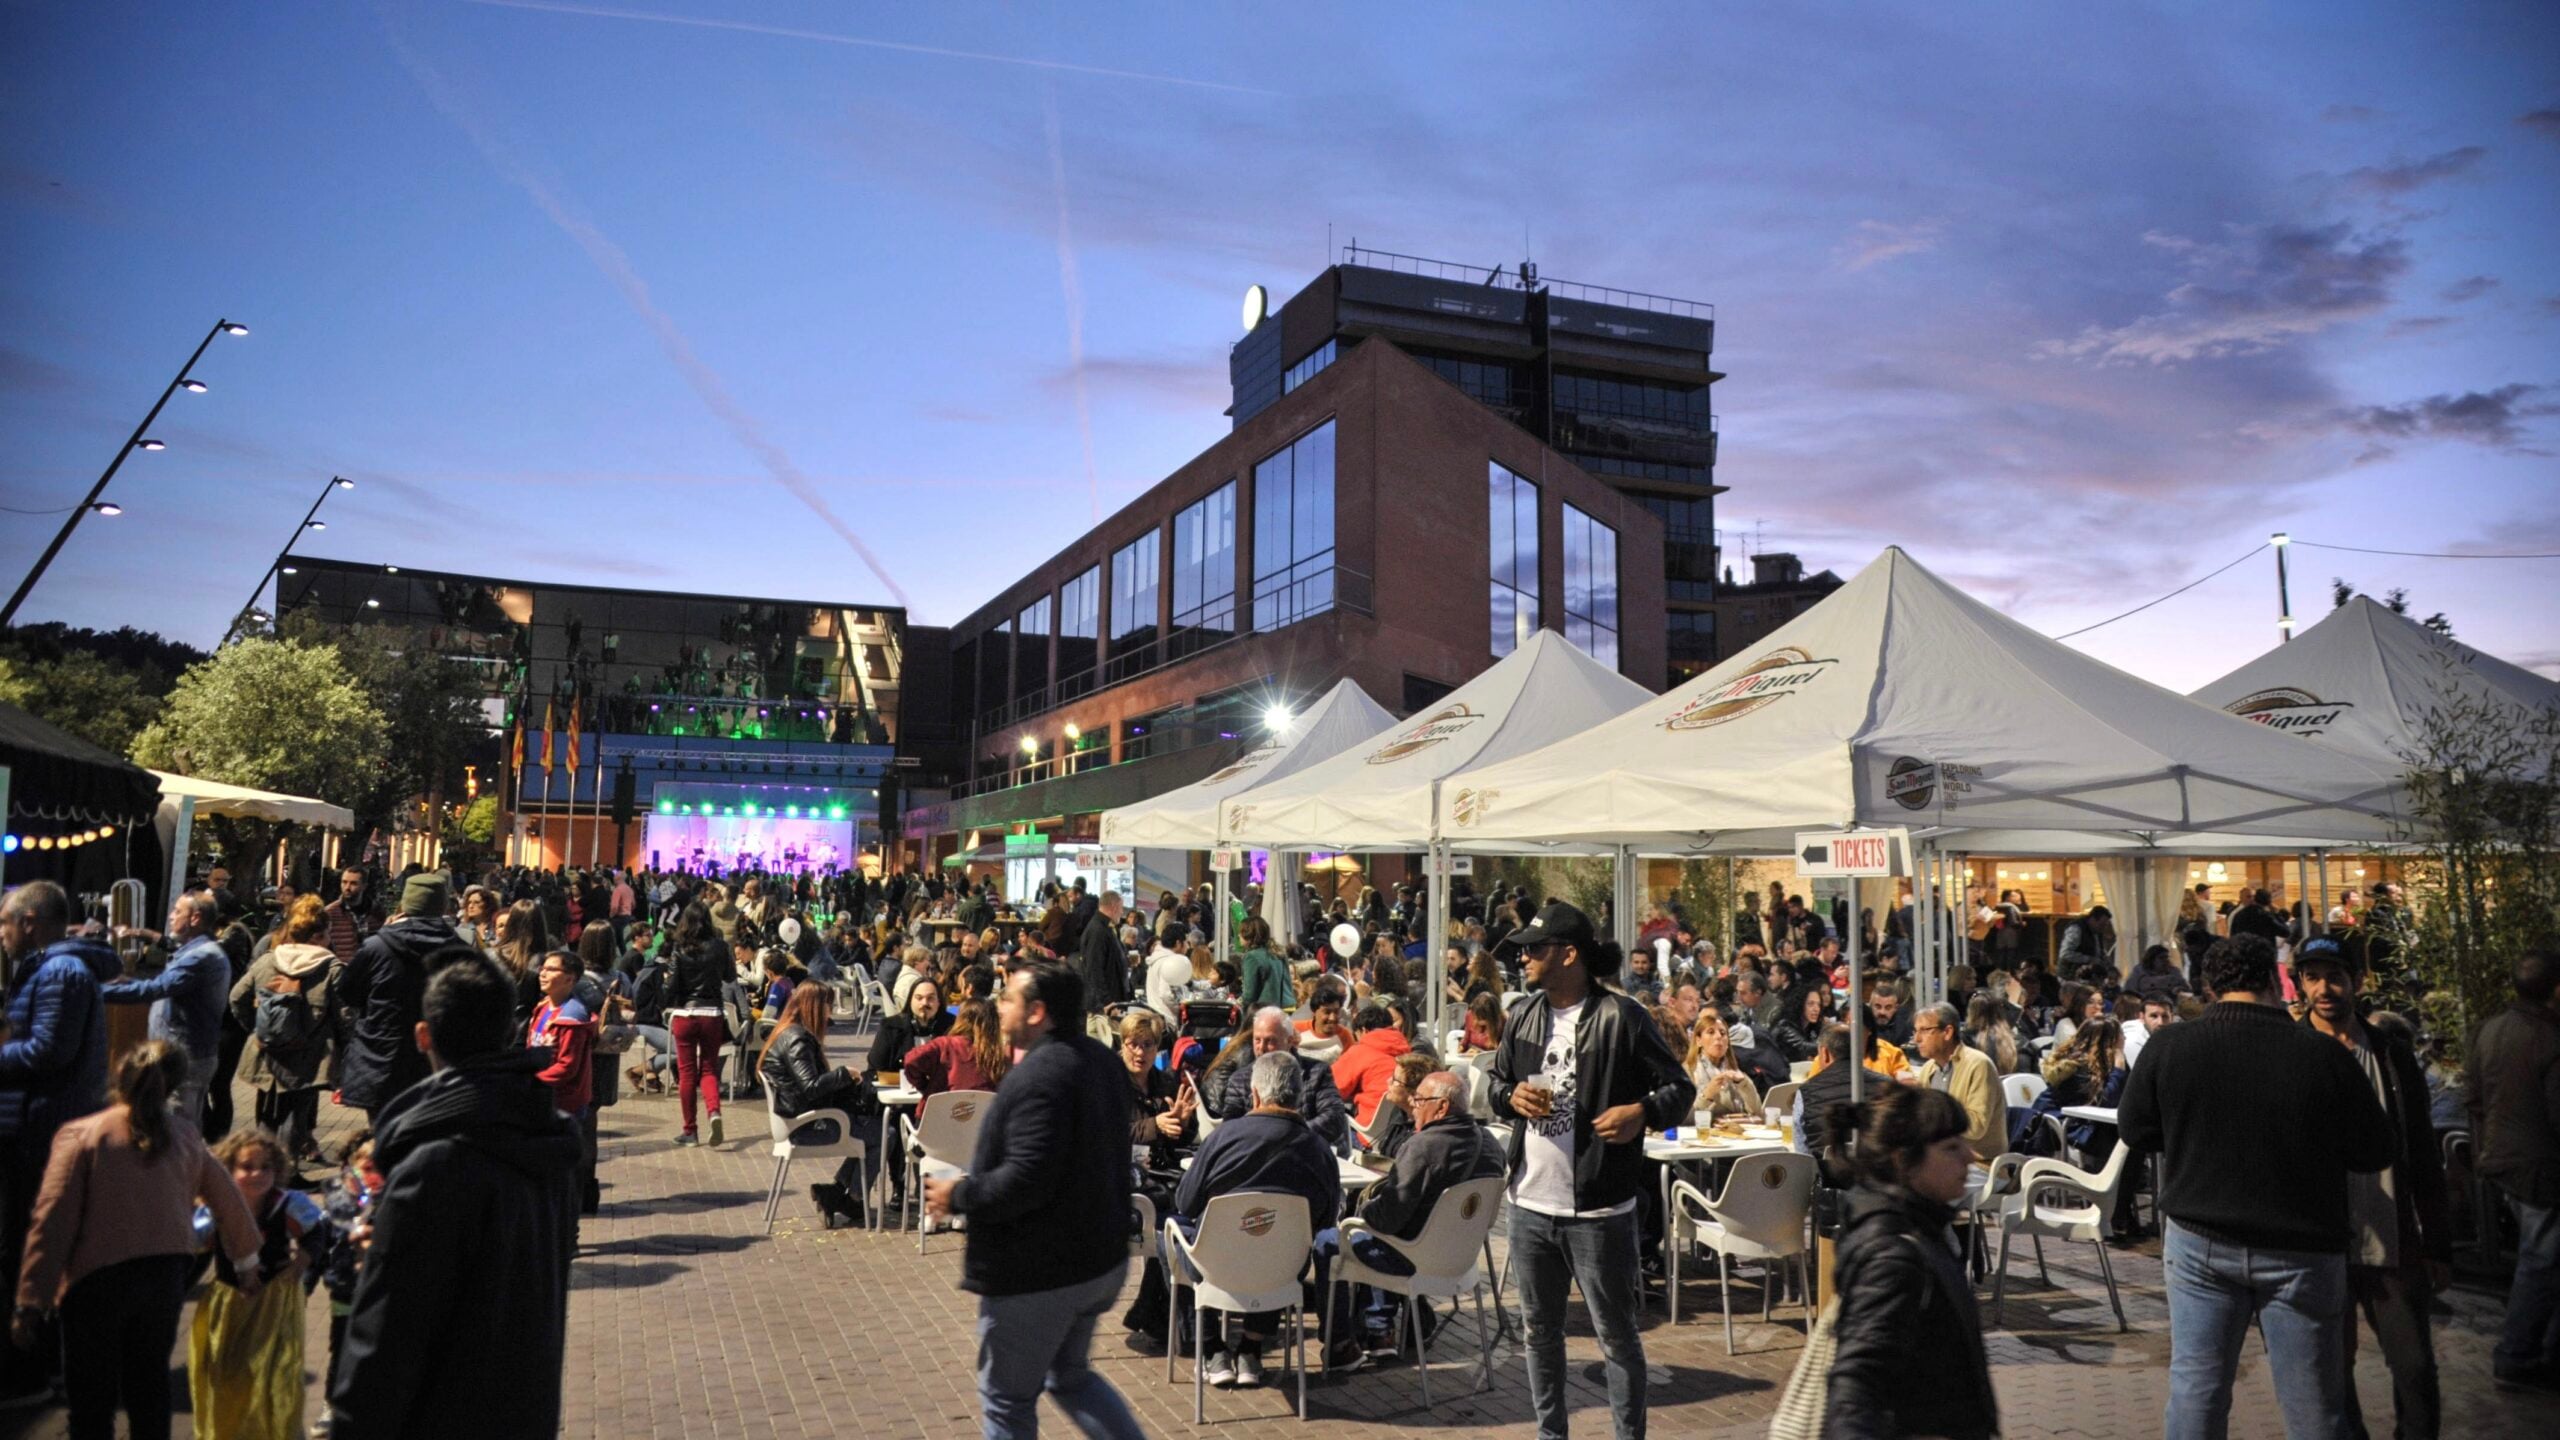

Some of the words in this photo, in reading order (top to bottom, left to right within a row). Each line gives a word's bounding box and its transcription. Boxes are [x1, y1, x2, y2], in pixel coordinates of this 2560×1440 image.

[1941, 763, 1983, 776] EXPLORING
[1943, 781, 1971, 792] WORLD
[1832, 837, 1885, 868] TICKETS
[1078, 854, 1091, 867] WC
[1539, 1117, 1576, 1137] LAGOO
